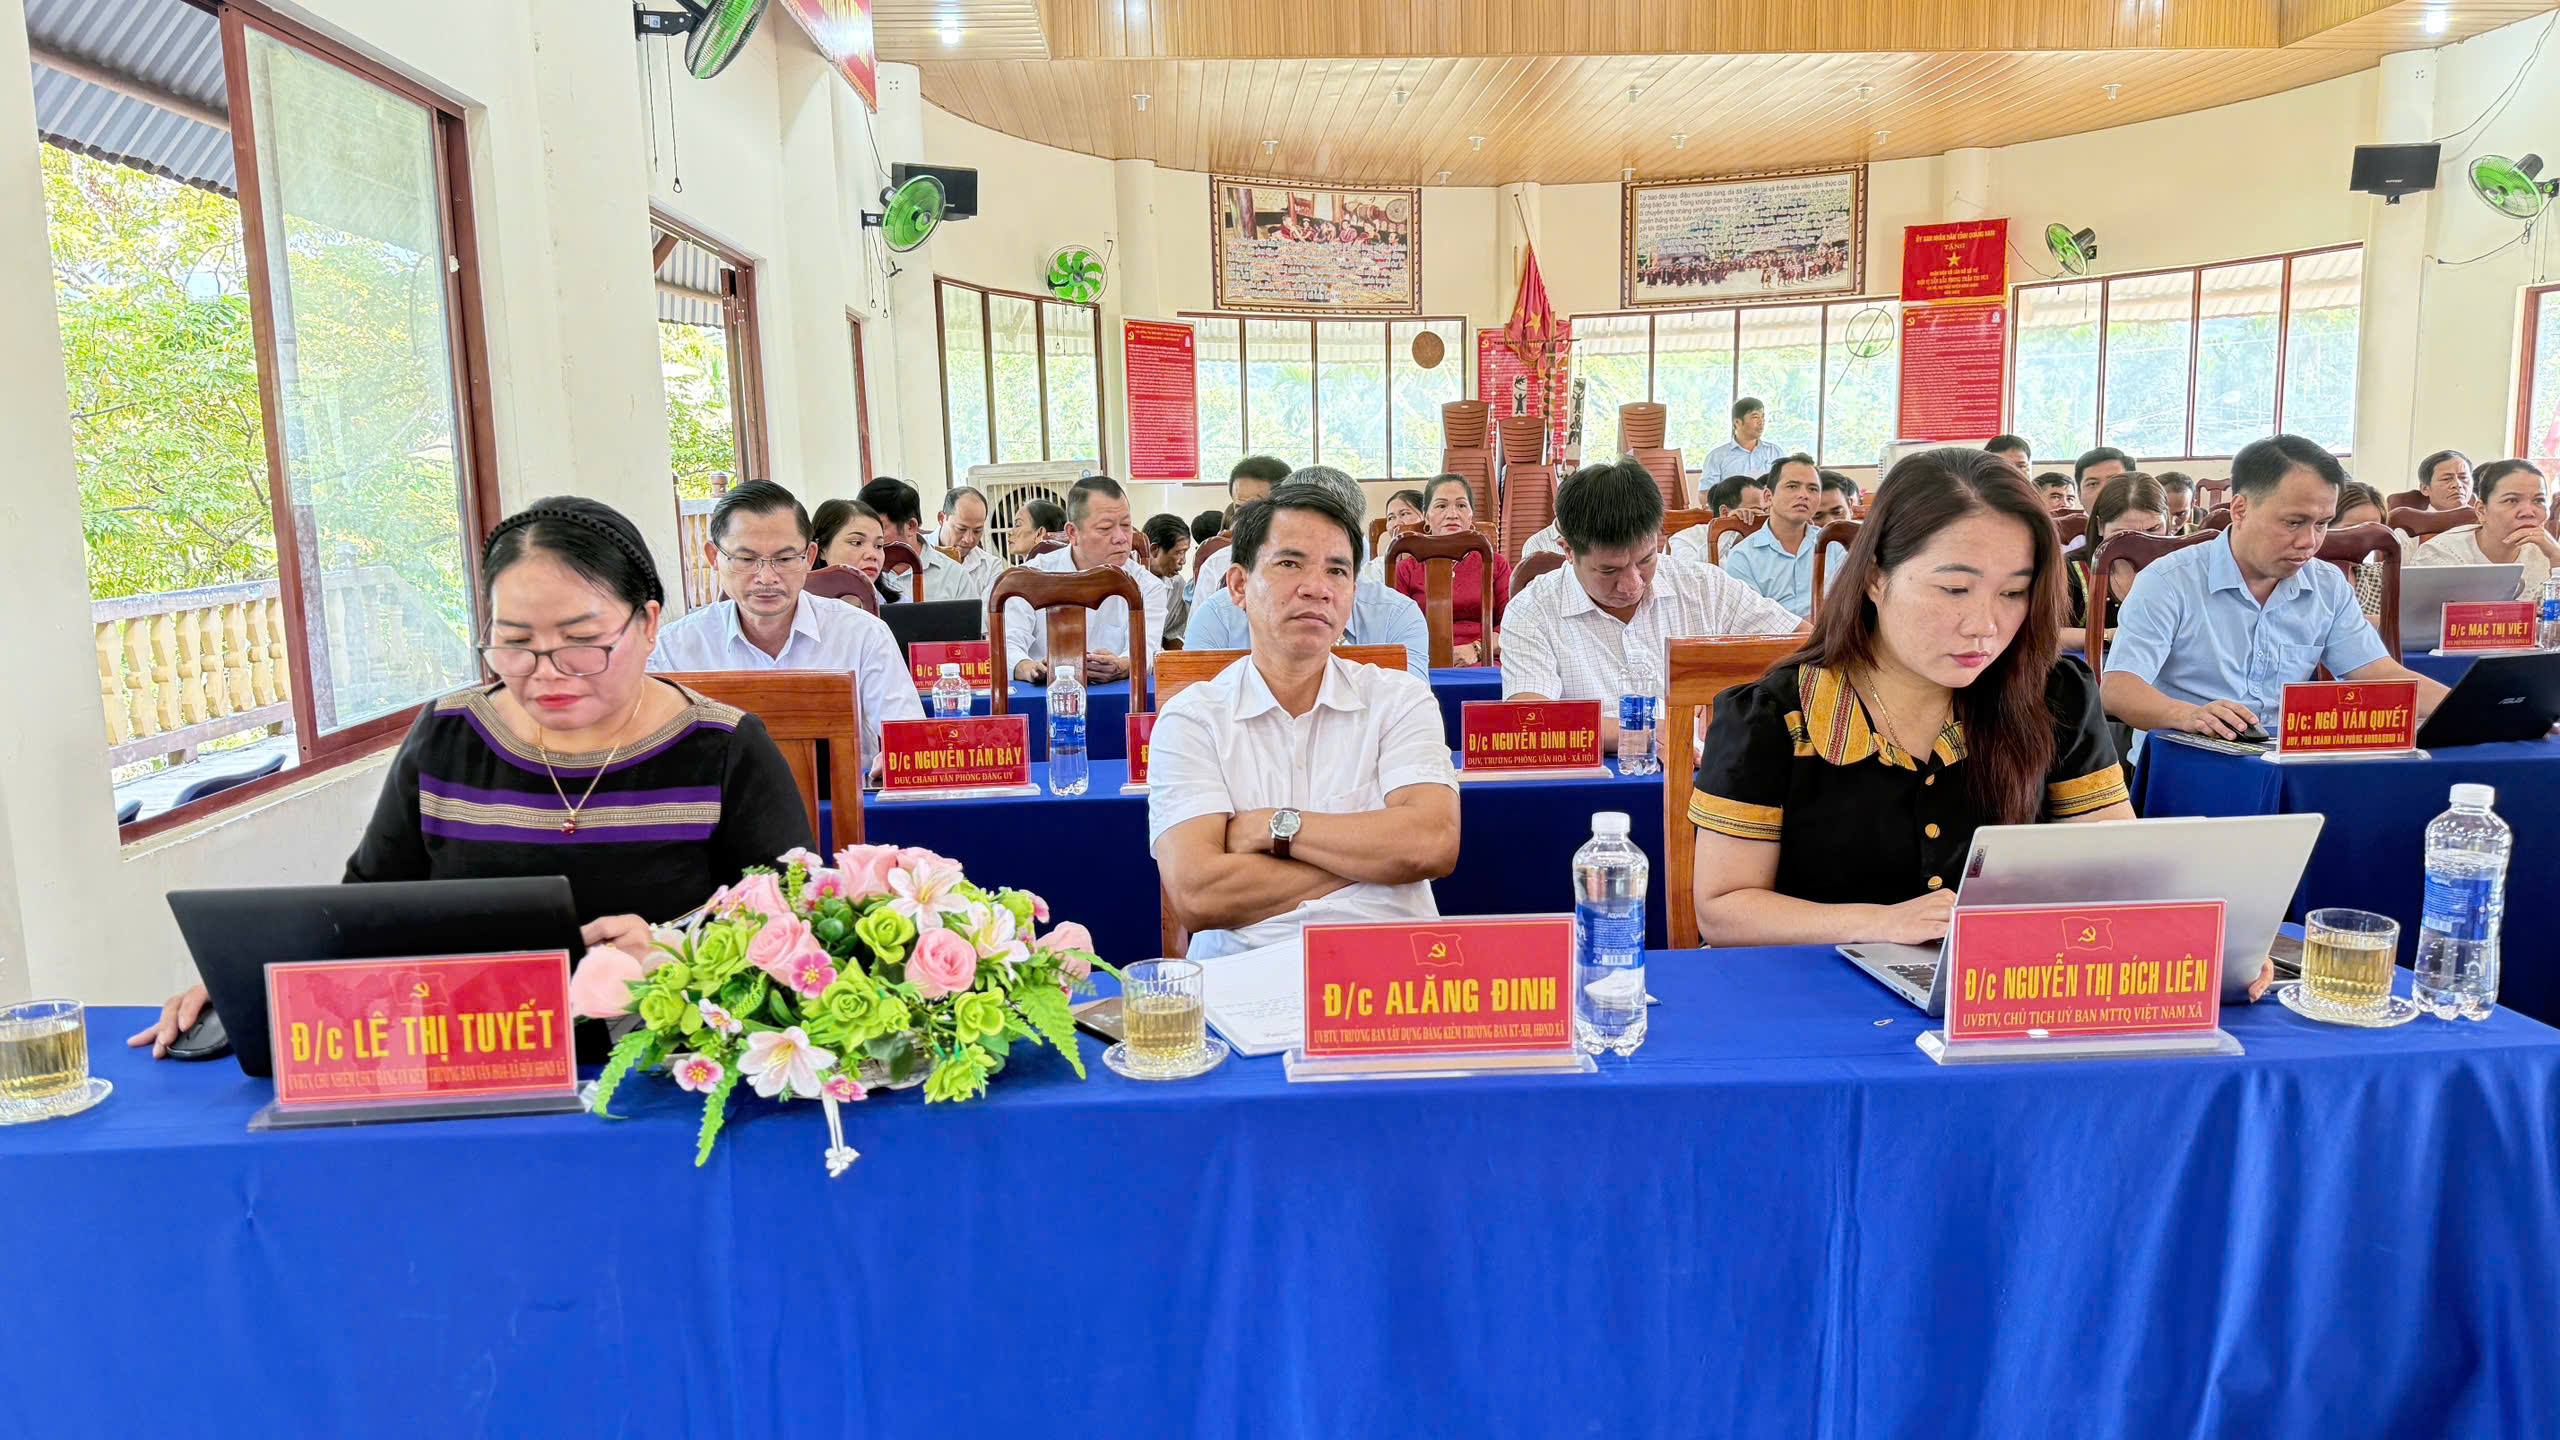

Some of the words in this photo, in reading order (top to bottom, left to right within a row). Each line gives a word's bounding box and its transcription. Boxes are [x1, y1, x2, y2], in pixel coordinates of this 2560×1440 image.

[2468, 623, 2489, 638] MẠC
[917, 664, 932, 678] Đ/c
[960, 662, 975, 678] THỊ
[2287, 711, 2312, 732] Đ/c:
[2315, 708, 2337, 729] NGÔ
[2342, 707, 2366, 729] VĂN
[2370, 704, 2408, 731] QUYẾT
[1468, 733, 1488, 753] Đ/c
[1492, 725, 1537, 751] NGUYỄN
[1541, 727, 1566, 750] ĐÌNH
[1569, 727, 1595, 752] HIỆP
[888, 753, 911, 773] Đ/c
[914, 743, 965, 770] NGUYỄN
[968, 742, 994, 767] TẤN
[997, 742, 1022, 765] BẢY
[1514, 754, 1537, 764] PHÒNG
[1538, 753, 1551, 763] VĂN
[912, 773, 938, 784] CHÁNH
[939, 773, 955, 783] VĂN
[955, 772, 981, 782] PHÒNG
[1965, 967, 1997, 1005] Đ/c
[2003, 951, 2079, 1001] NGUYỄN
[2085, 962, 2114, 1002] THỊ
[2119, 957, 2160, 996] BÍCH
[2165, 953, 2209, 994] LIÊN
[1322, 982, 1373, 1021] Đ/c
[1385, 973, 1480, 1017] ALĂNG
[1490, 976, 1557, 1013] ĐINH
[1963, 1012, 2001, 1028] UVBTV,
[2003, 1007, 2027, 1026] CHỦ
[2029, 1010, 2055, 1028] TỊCH
[2075, 1008, 2098, 1023] BAN
[2100, 1007, 2131, 1024] MTTQ
[2134, 1002, 2159, 1024] VIỆT
[2161, 1004, 2186, 1020] NAM
[2188, 1000, 2203, 1019] XÃ
[290, 1020, 343, 1065] Đ/c
[352, 1009, 390, 1059] LÊ
[400, 1014, 449, 1062] THỊ
[457, 997, 555, 1053] TUYẾT
[1340, 1024, 1371, 1043] TRƯỞNG
[1371, 1027, 1387, 1042] BAN
[1462, 1022, 1493, 1039] TRƯỞNG
[1493, 1023, 1508, 1038] BAN
[1533, 1022, 1554, 1038] HĐND
[1555, 1019, 1566, 1037] XÃ
